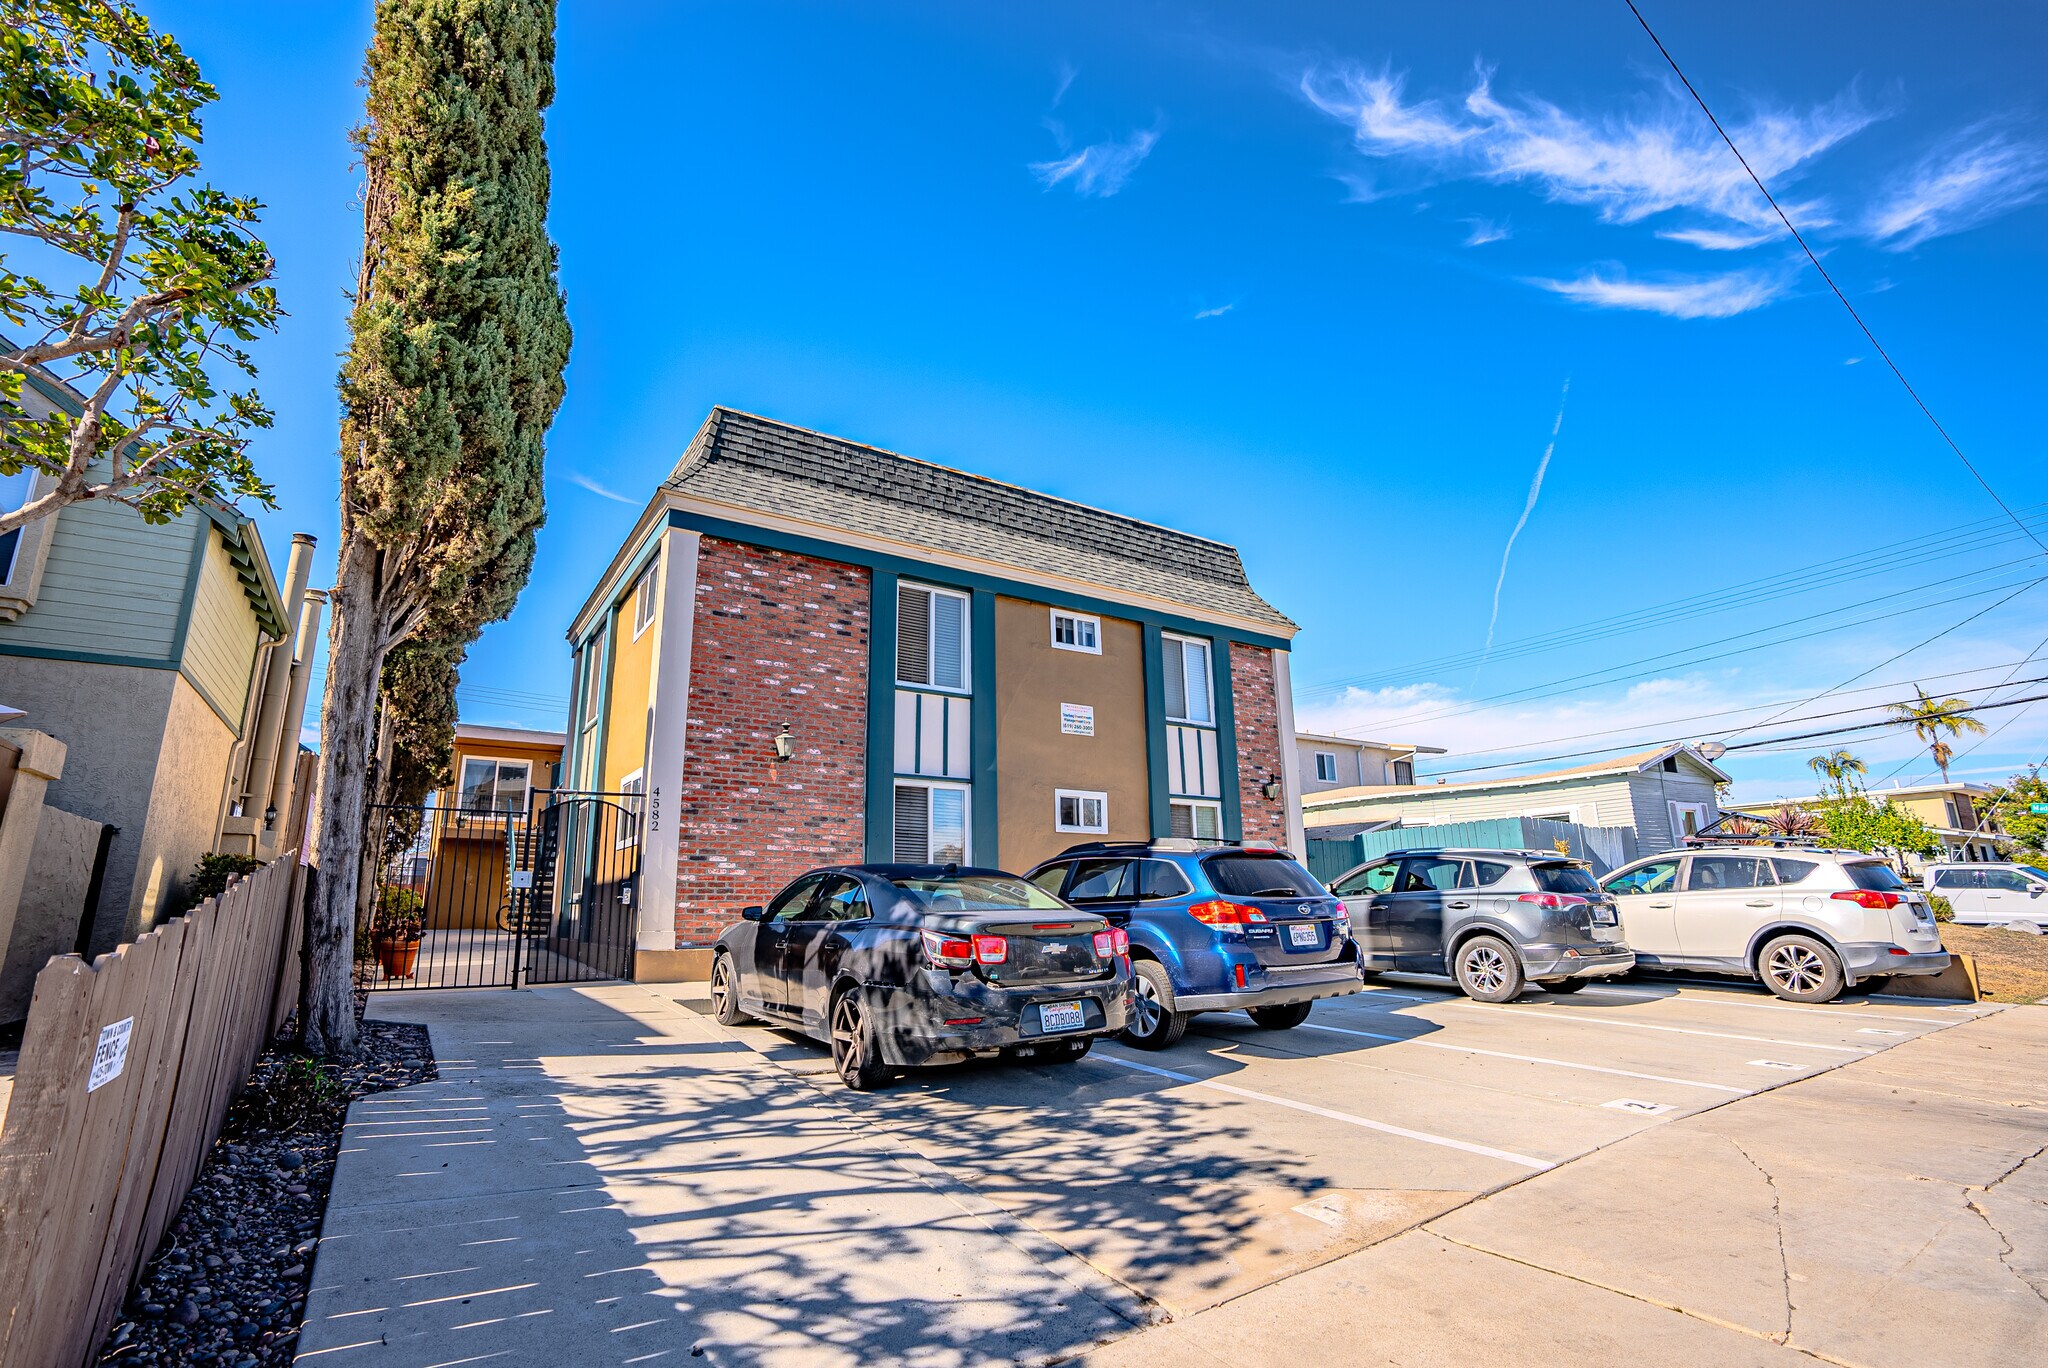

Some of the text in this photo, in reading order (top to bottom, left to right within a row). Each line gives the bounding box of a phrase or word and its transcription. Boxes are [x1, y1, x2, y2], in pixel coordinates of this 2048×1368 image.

[651, 786, 660, 831] 4582
[1044, 1011, 1080, 1027] 8CDB088
[101, 1028, 113, 1042] TOWN
[95, 1038, 120, 1066] FENCE
